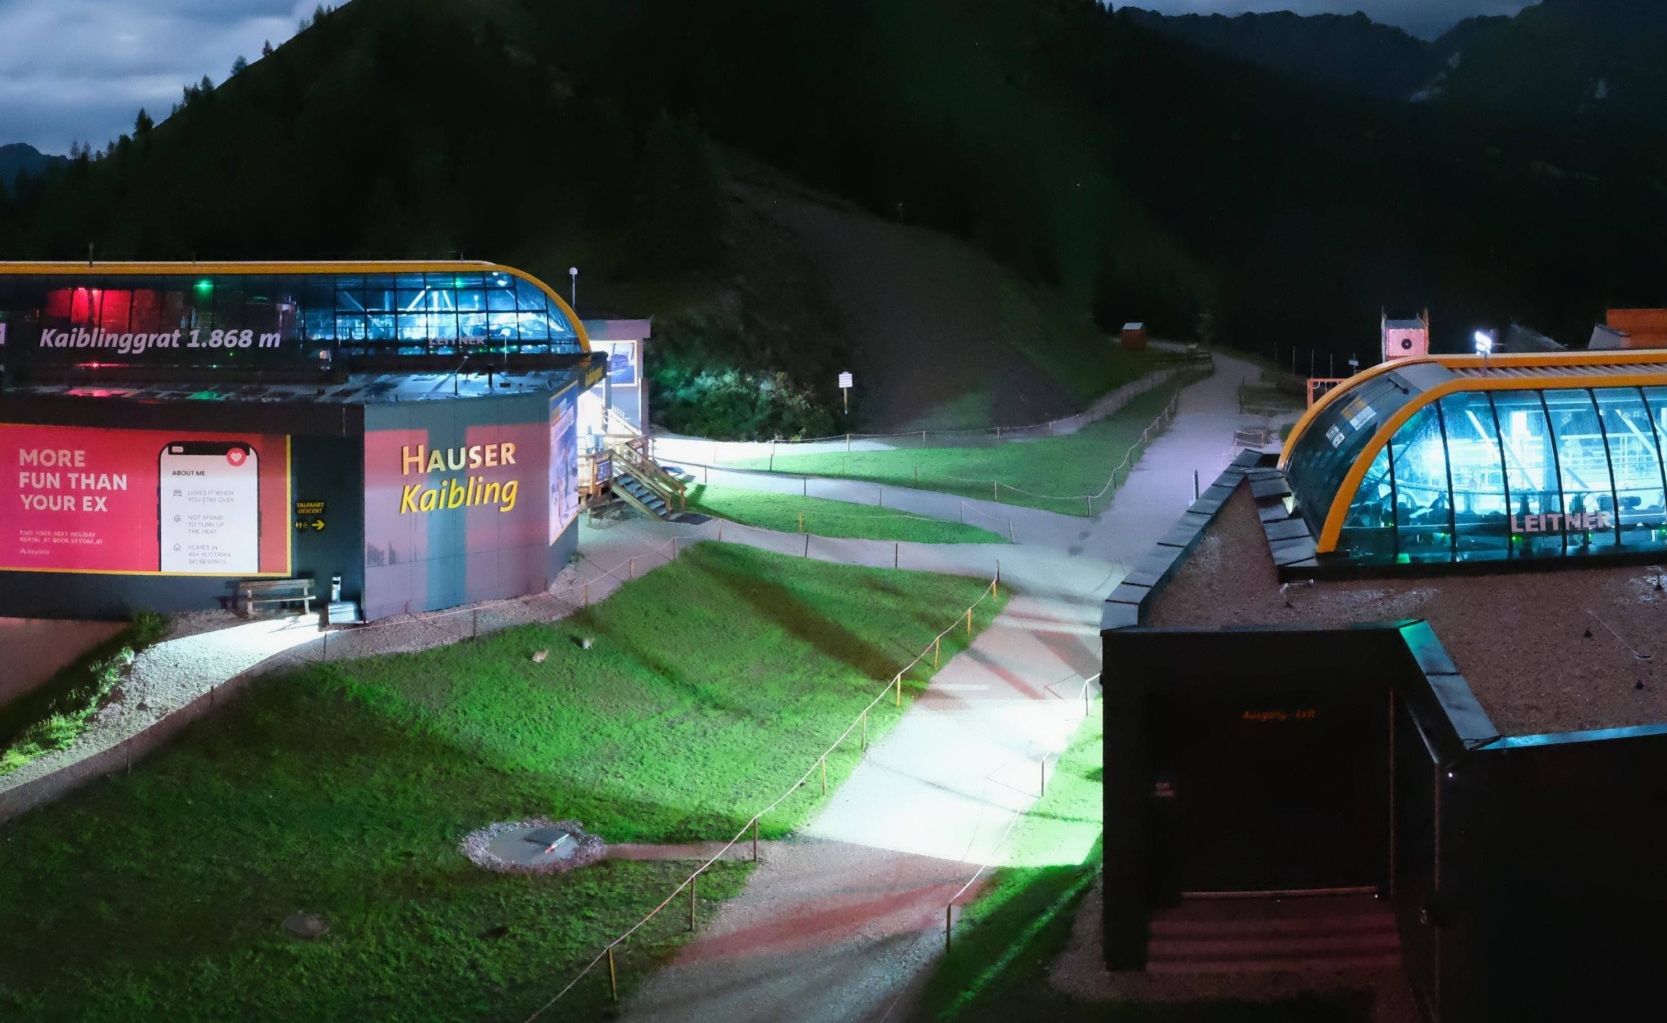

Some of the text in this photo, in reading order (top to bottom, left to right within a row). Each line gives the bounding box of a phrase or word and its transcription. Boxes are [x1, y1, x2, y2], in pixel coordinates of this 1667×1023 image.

[39, 327, 281, 354] Kaiblinggrat 1.868 m
[19, 449, 86, 467] MORE
[402, 442, 516, 475] HAUSER
[19, 472, 128, 491] FUN THAN
[20, 494, 108, 512] YOUR EX
[400, 476, 519, 514] Kaibling
[1510, 510, 1613, 533] LEITNER
[1242, 710, 1288, 721] Ausgang
[1296, 708, 1316, 719] Exit
